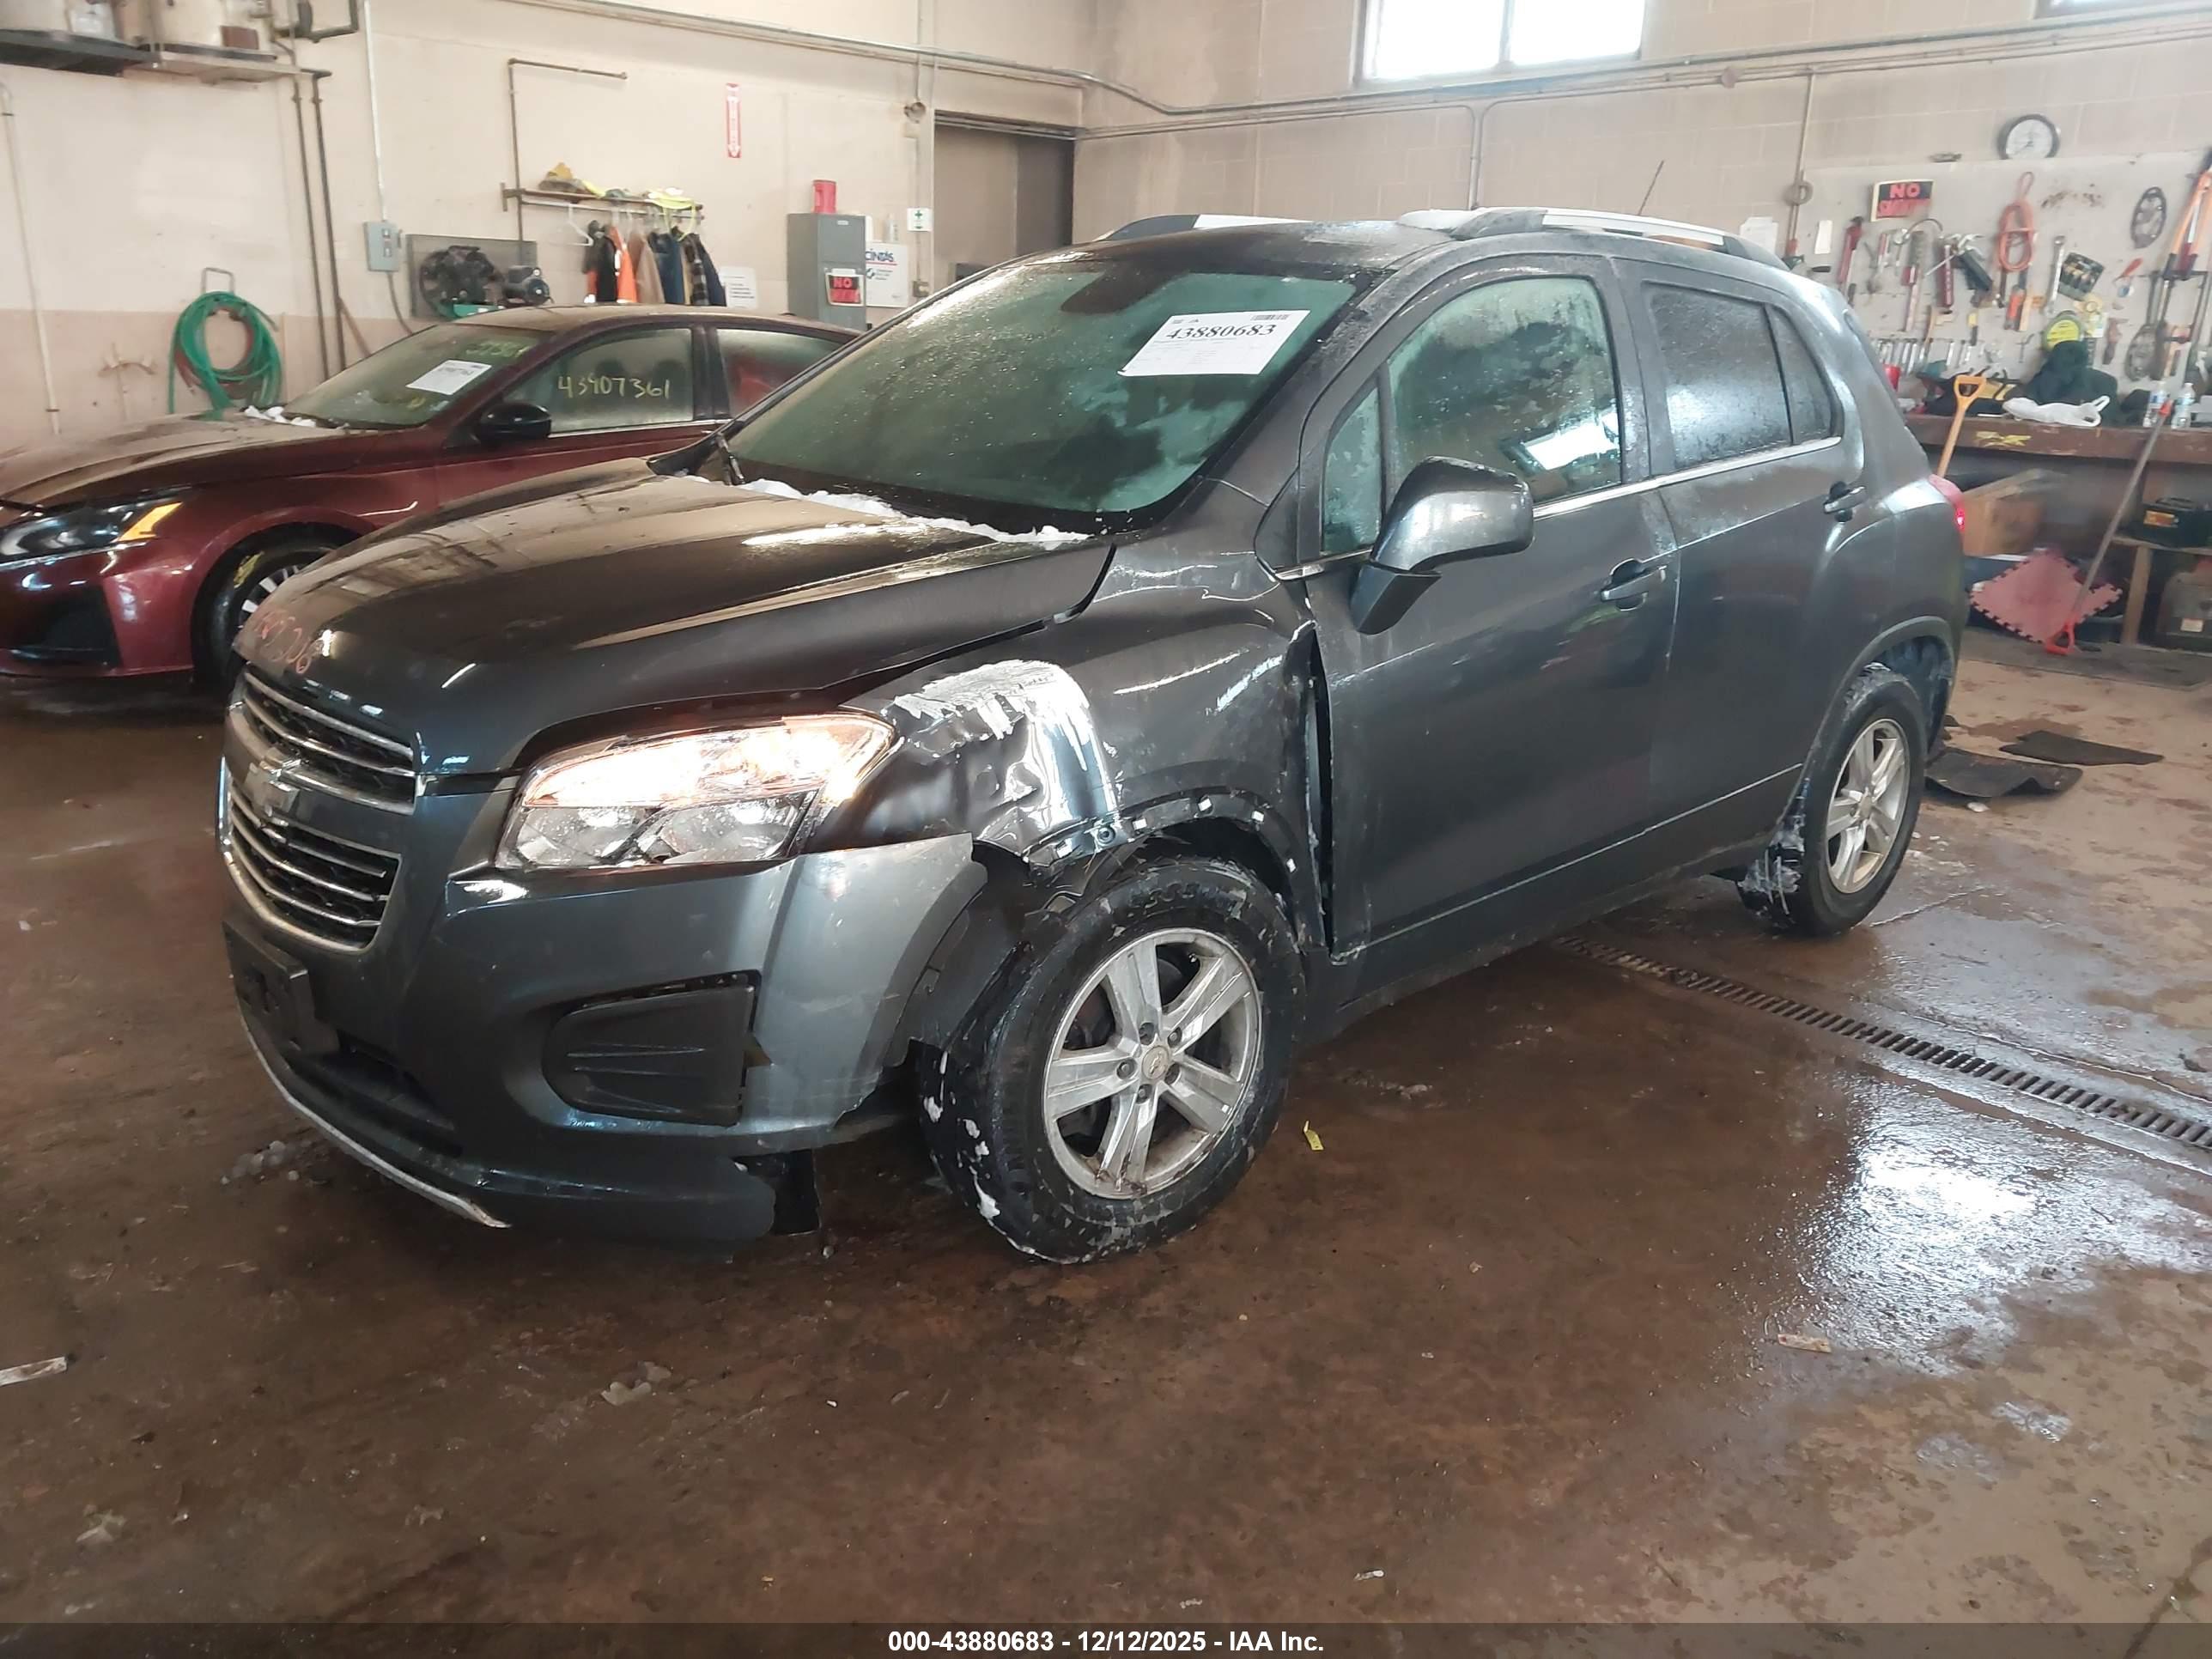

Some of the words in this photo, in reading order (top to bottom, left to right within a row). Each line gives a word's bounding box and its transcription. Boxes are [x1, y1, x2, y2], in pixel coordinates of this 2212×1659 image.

[1890, 182, 1920, 198] NO
[834, 277, 852, 288] NO
[1166, 325, 1277, 339] 43880683
[558, 373, 670, 398] 43907361
